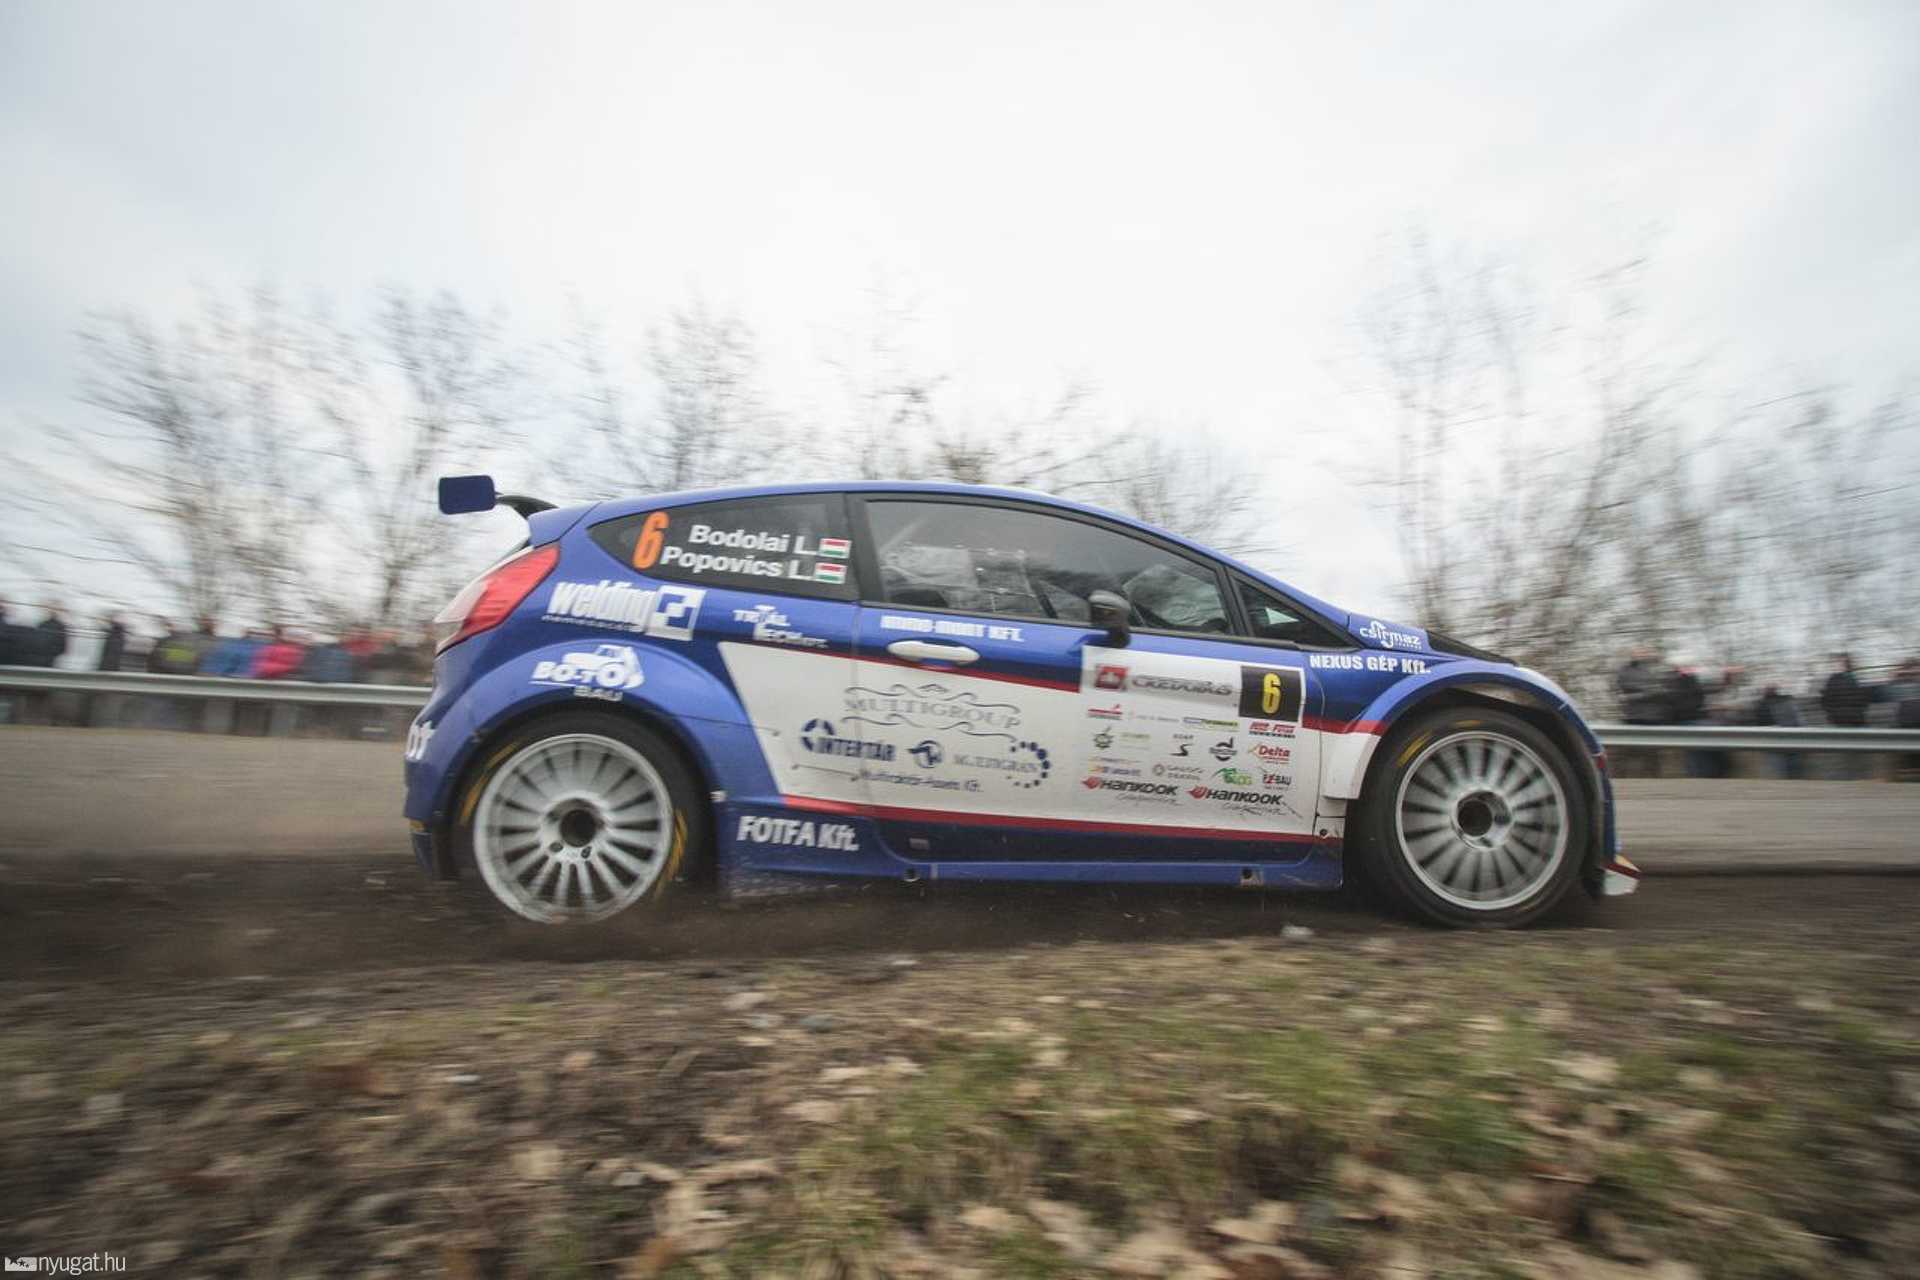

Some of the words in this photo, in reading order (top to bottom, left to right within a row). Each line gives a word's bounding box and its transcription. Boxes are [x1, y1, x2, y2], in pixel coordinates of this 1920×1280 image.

[632, 511, 670, 570] 6
[689, 524, 791, 553] Bodolai
[660, 545, 784, 577] Popovics
[1309, 654, 1364, 670] NEXUS
[1367, 655, 1398, 672] GÉP
[1262, 672, 1281, 714] 6
[1259, 745, 1290, 757] Delta
